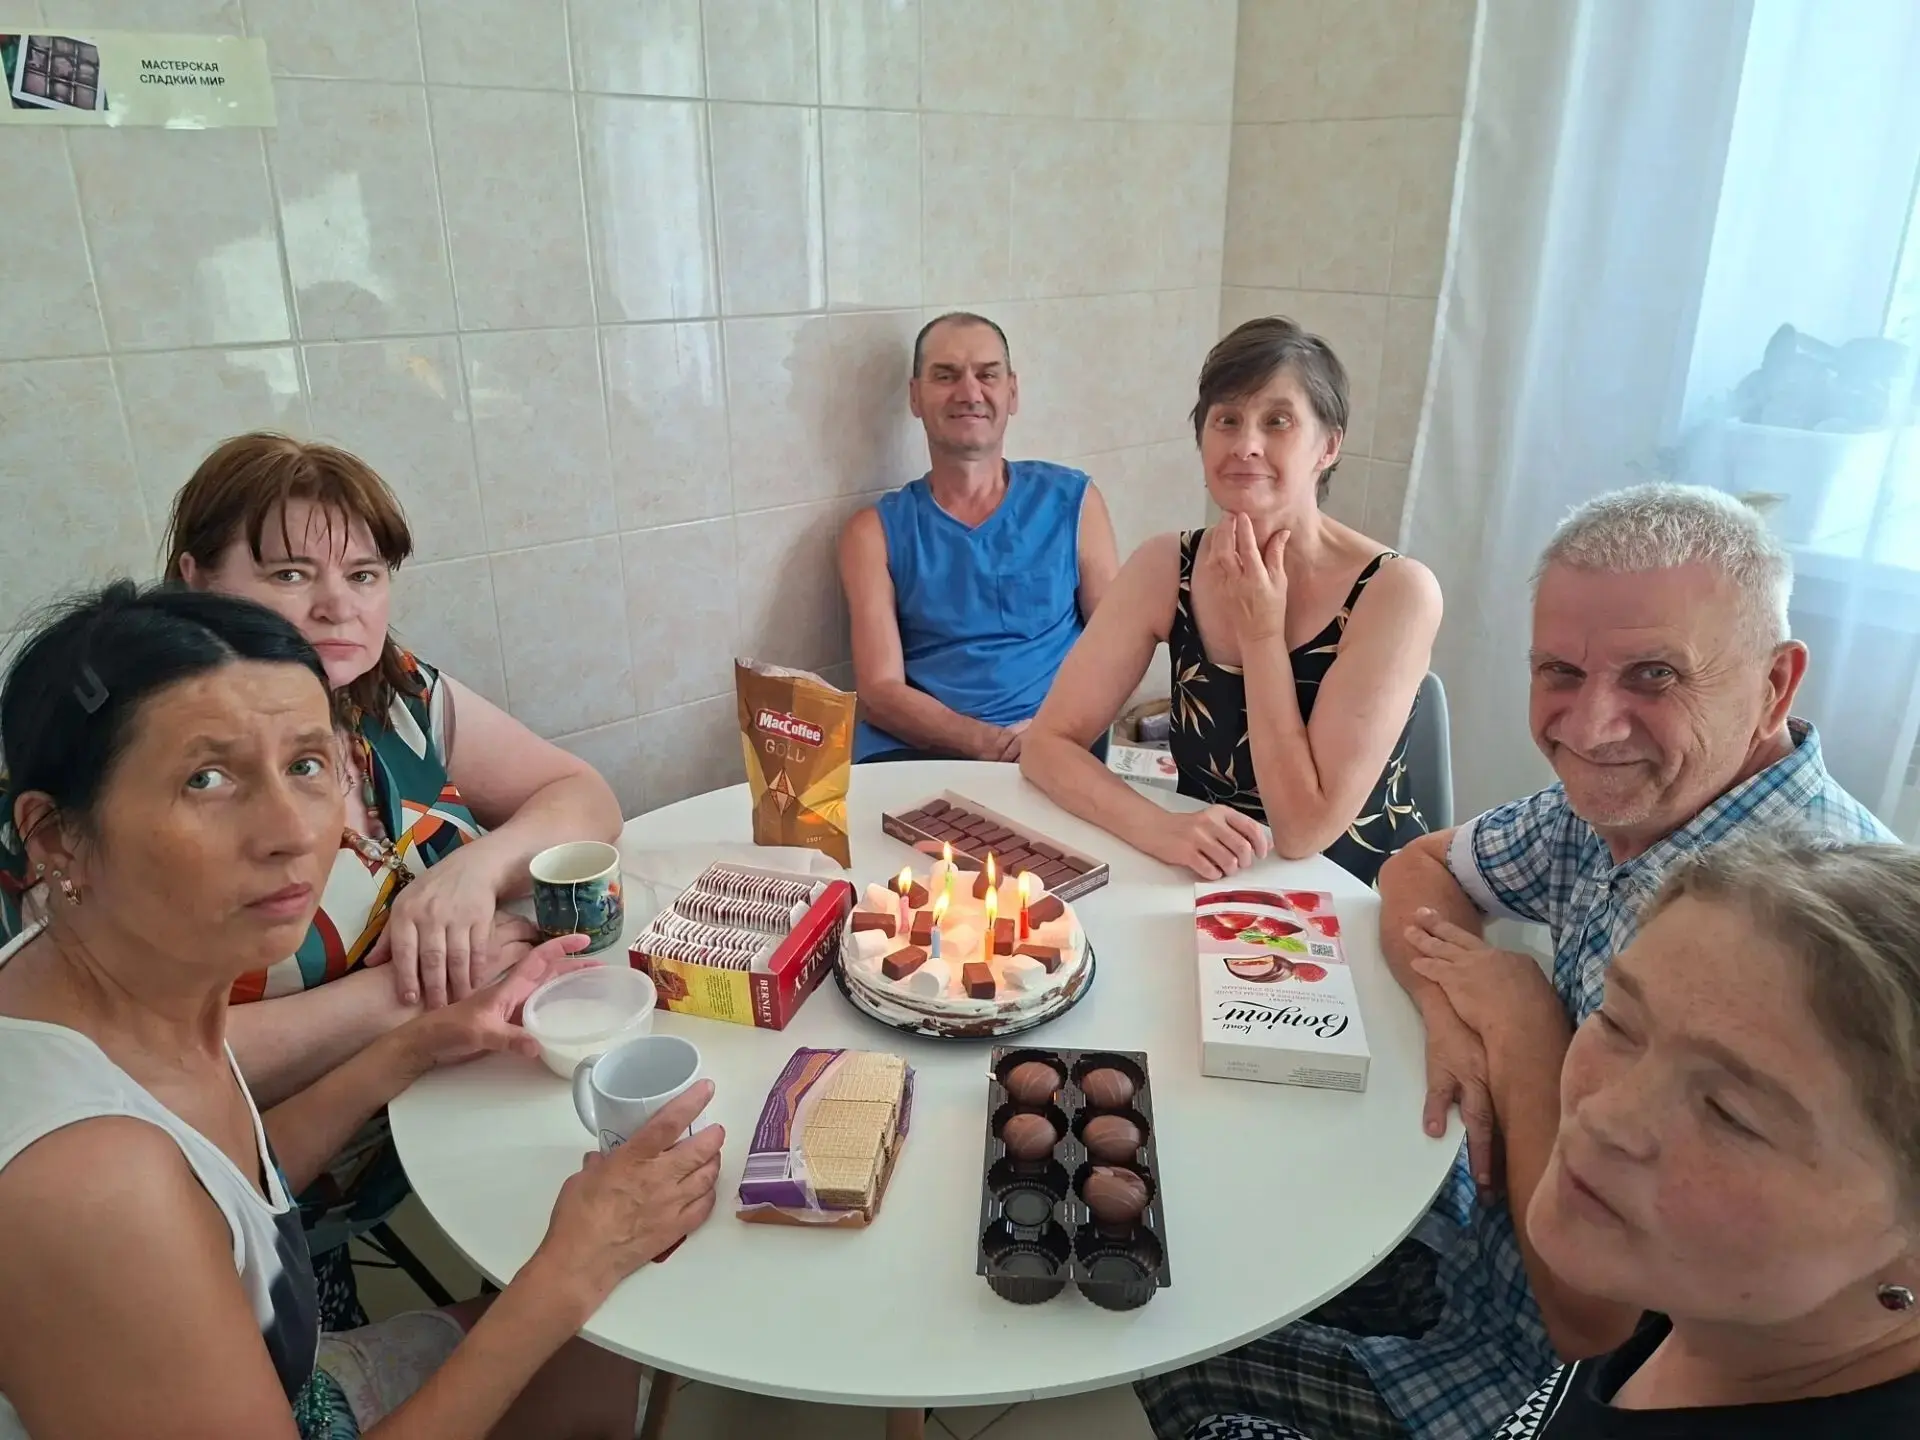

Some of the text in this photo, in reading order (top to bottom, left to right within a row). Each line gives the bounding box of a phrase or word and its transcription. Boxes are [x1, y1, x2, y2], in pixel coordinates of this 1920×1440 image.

[140, 74, 225, 86] СЛАДКИЙ МИР
[141, 60, 219, 72] МАСТЕРСКАЯ
[759, 712, 821, 741] MacCoffee
[765, 739, 806, 764] GOLD
[793, 919, 843, 1000] BERNLEY
[758, 979, 773, 1024] BERNLEY
[1212, 1000, 1349, 1038] Bonjour
